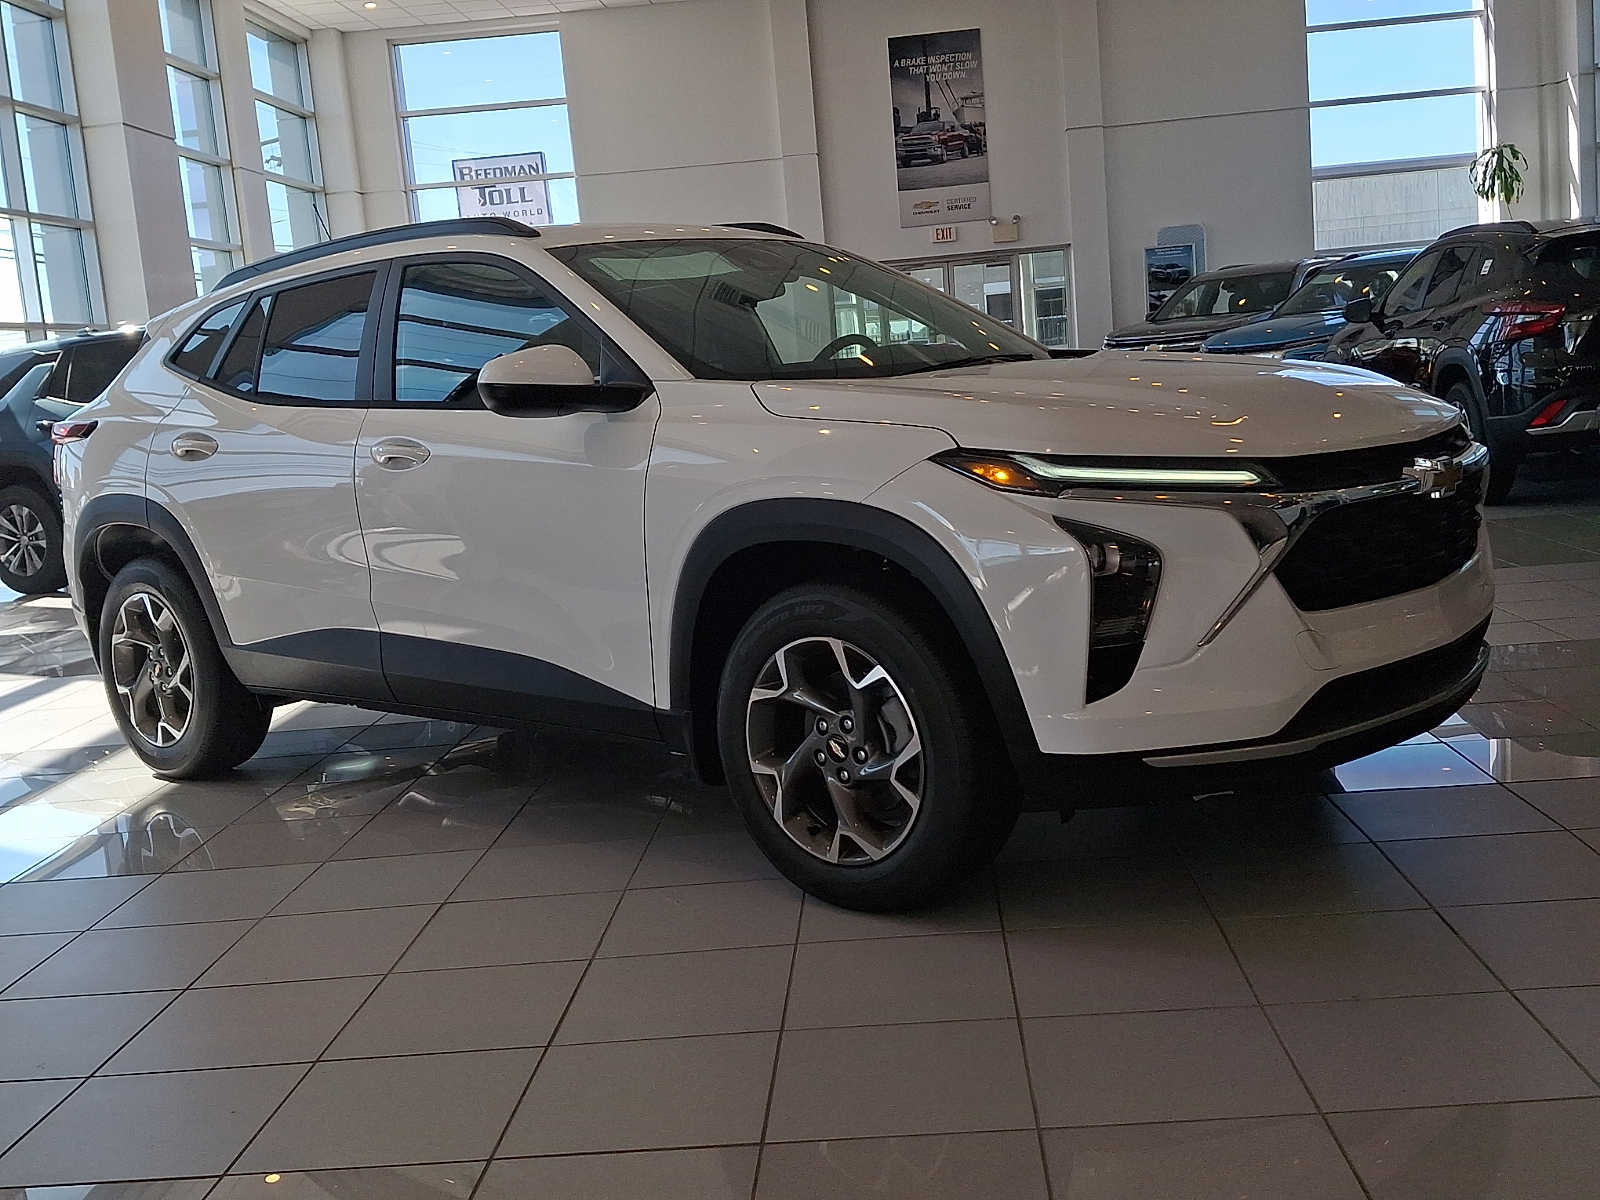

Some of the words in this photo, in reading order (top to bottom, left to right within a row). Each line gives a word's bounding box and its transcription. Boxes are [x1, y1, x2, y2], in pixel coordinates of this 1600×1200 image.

[893, 59, 900, 68] A
[900, 56, 927, 67] BRAKE
[927, 52, 972, 64] INSPECTION
[909, 65, 929, 76] THAT
[929, 62, 954, 73] WON'T
[955, 60, 978, 70] SLOW
[925, 73, 942, 82] YOU
[471, 185, 534, 207] TOLL
[503, 208, 543, 218] WORLD
[946, 203, 972, 211] SERVICE
[935, 227, 953, 241] EXIT
